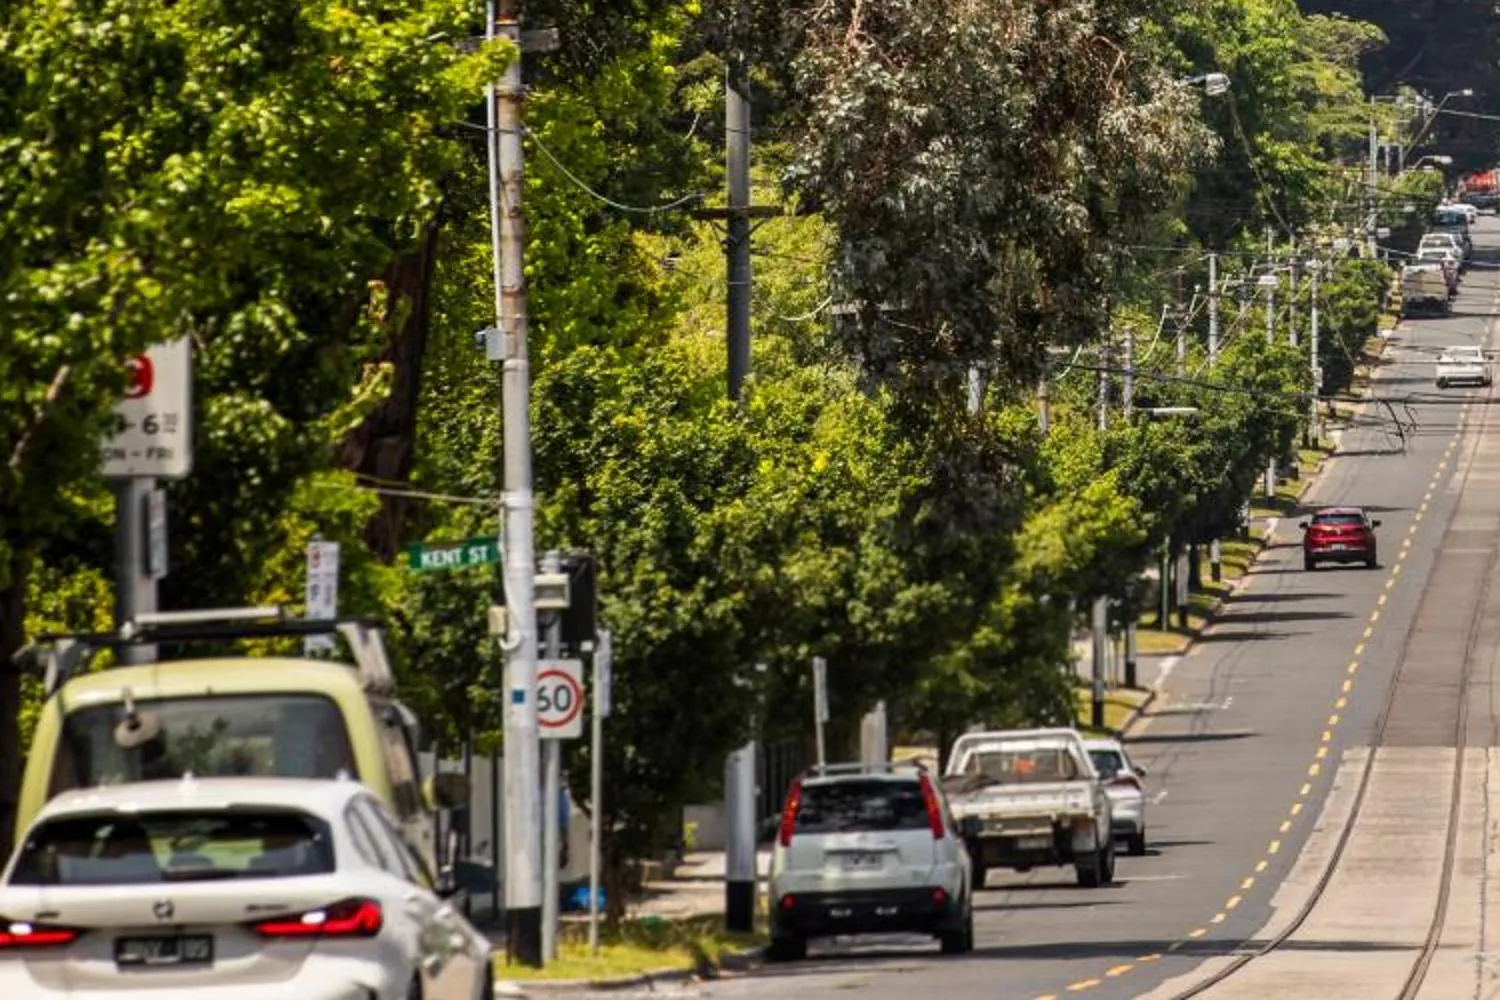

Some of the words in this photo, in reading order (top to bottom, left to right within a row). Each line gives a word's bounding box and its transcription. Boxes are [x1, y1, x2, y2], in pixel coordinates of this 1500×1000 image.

[421, 548, 462, 569] KENT
[469, 546, 488, 565] ST
[537, 685, 572, 713] 60
